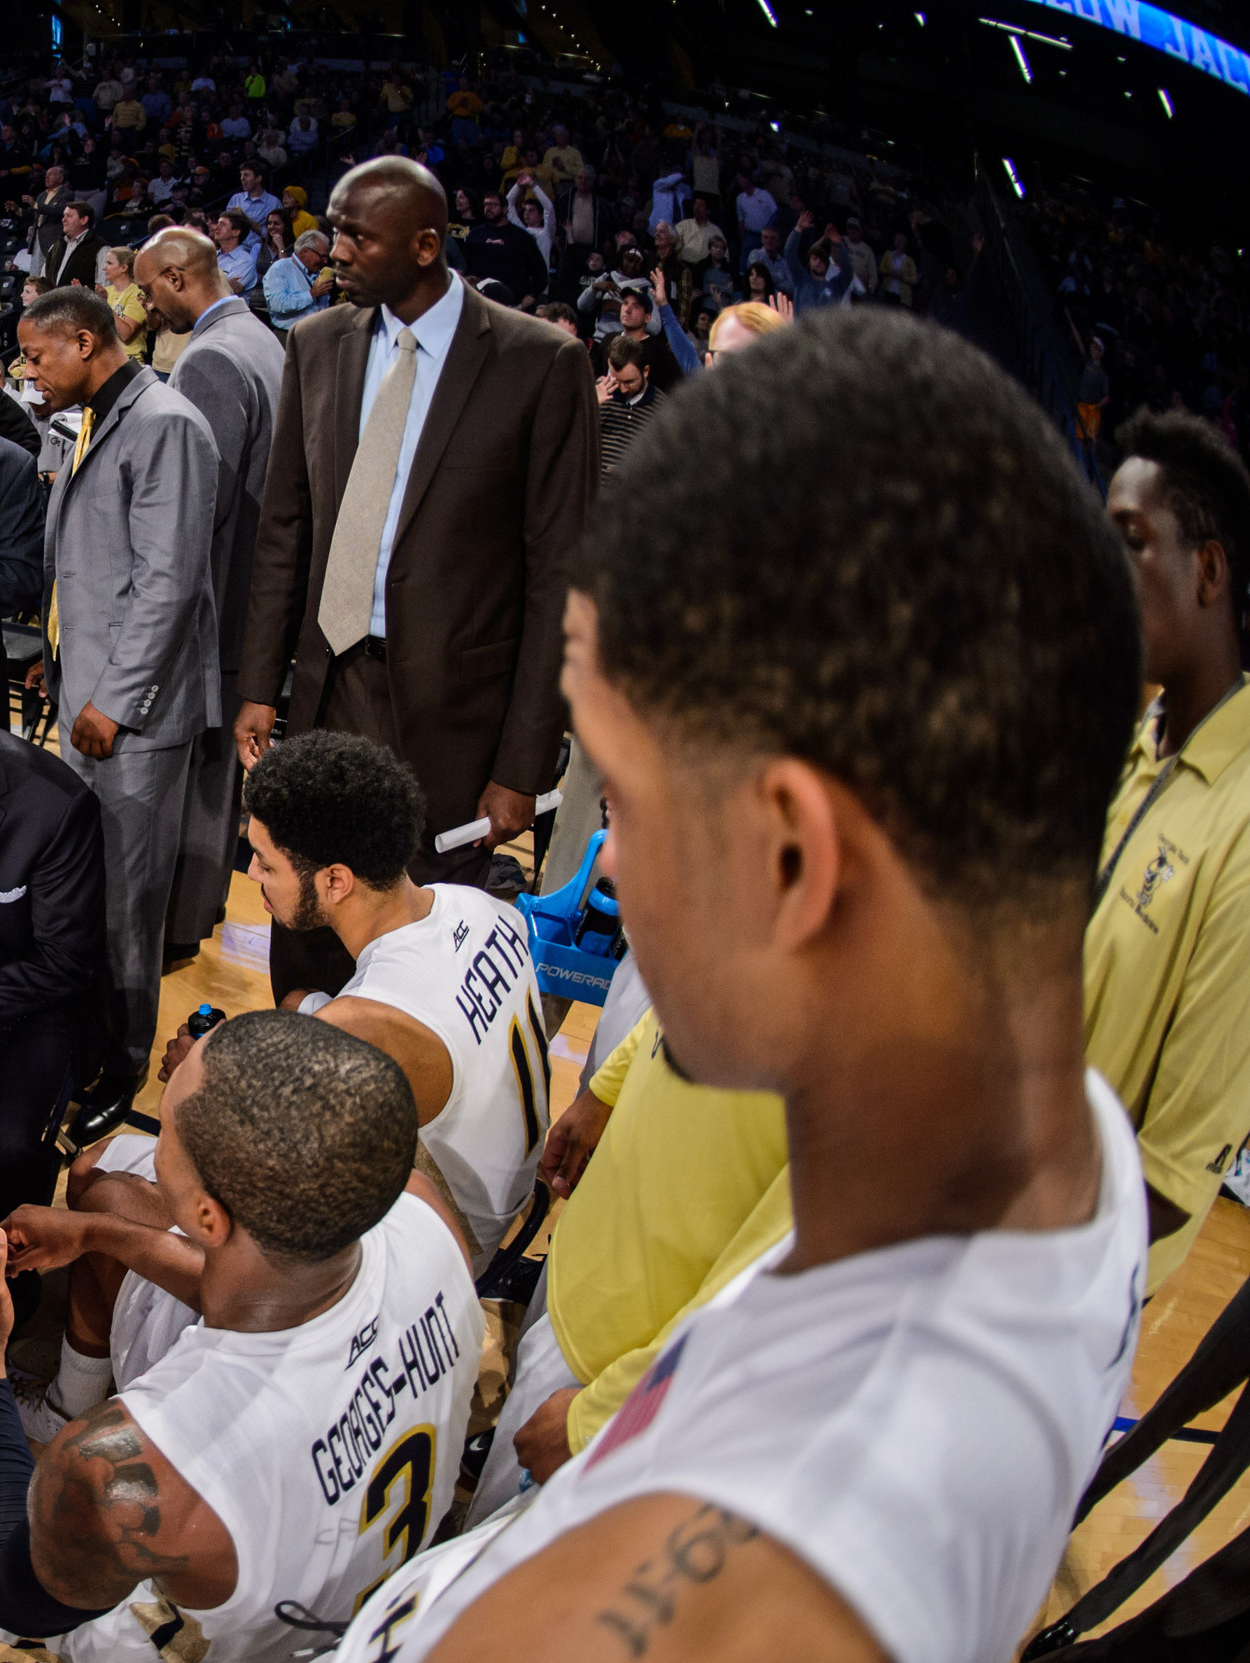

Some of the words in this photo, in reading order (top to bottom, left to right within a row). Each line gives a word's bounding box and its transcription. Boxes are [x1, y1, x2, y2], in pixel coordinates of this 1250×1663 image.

[1164, 14, 1250, 93] JAC
[452, 919, 470, 953] ACC
[455, 915, 529, 1045] HEATH
[344, 1316, 380, 1371] ACC
[311, 1290, 460, 1507] GEORGES-HUNT
[352, 1422, 437, 1617] 3
